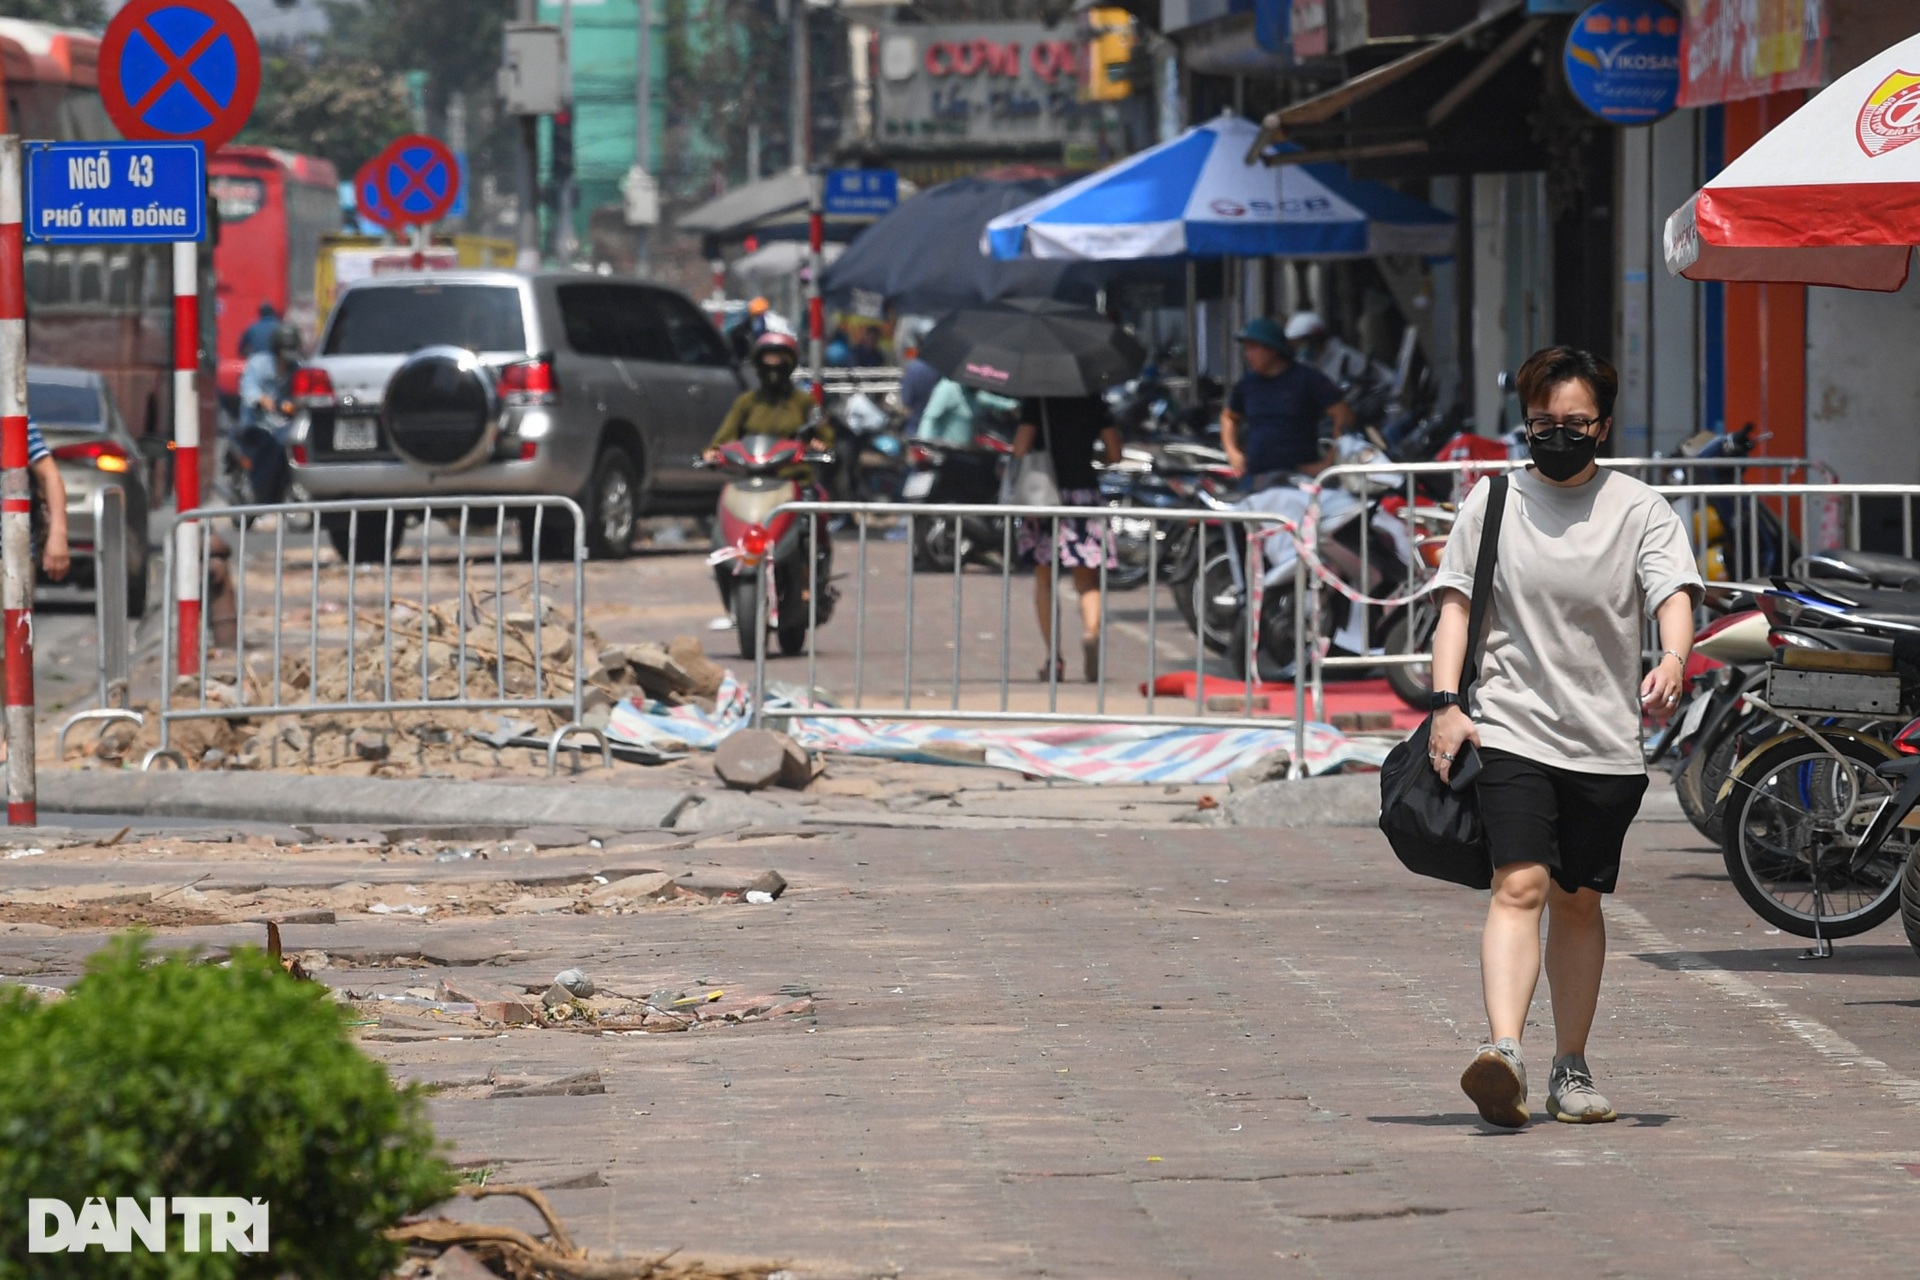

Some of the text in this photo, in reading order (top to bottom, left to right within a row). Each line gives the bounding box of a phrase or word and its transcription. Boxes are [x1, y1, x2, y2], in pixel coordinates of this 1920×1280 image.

[68, 150, 154, 190] NGÕ 43
[42, 201, 186, 227] PHỐ KIM ĐỒNG
